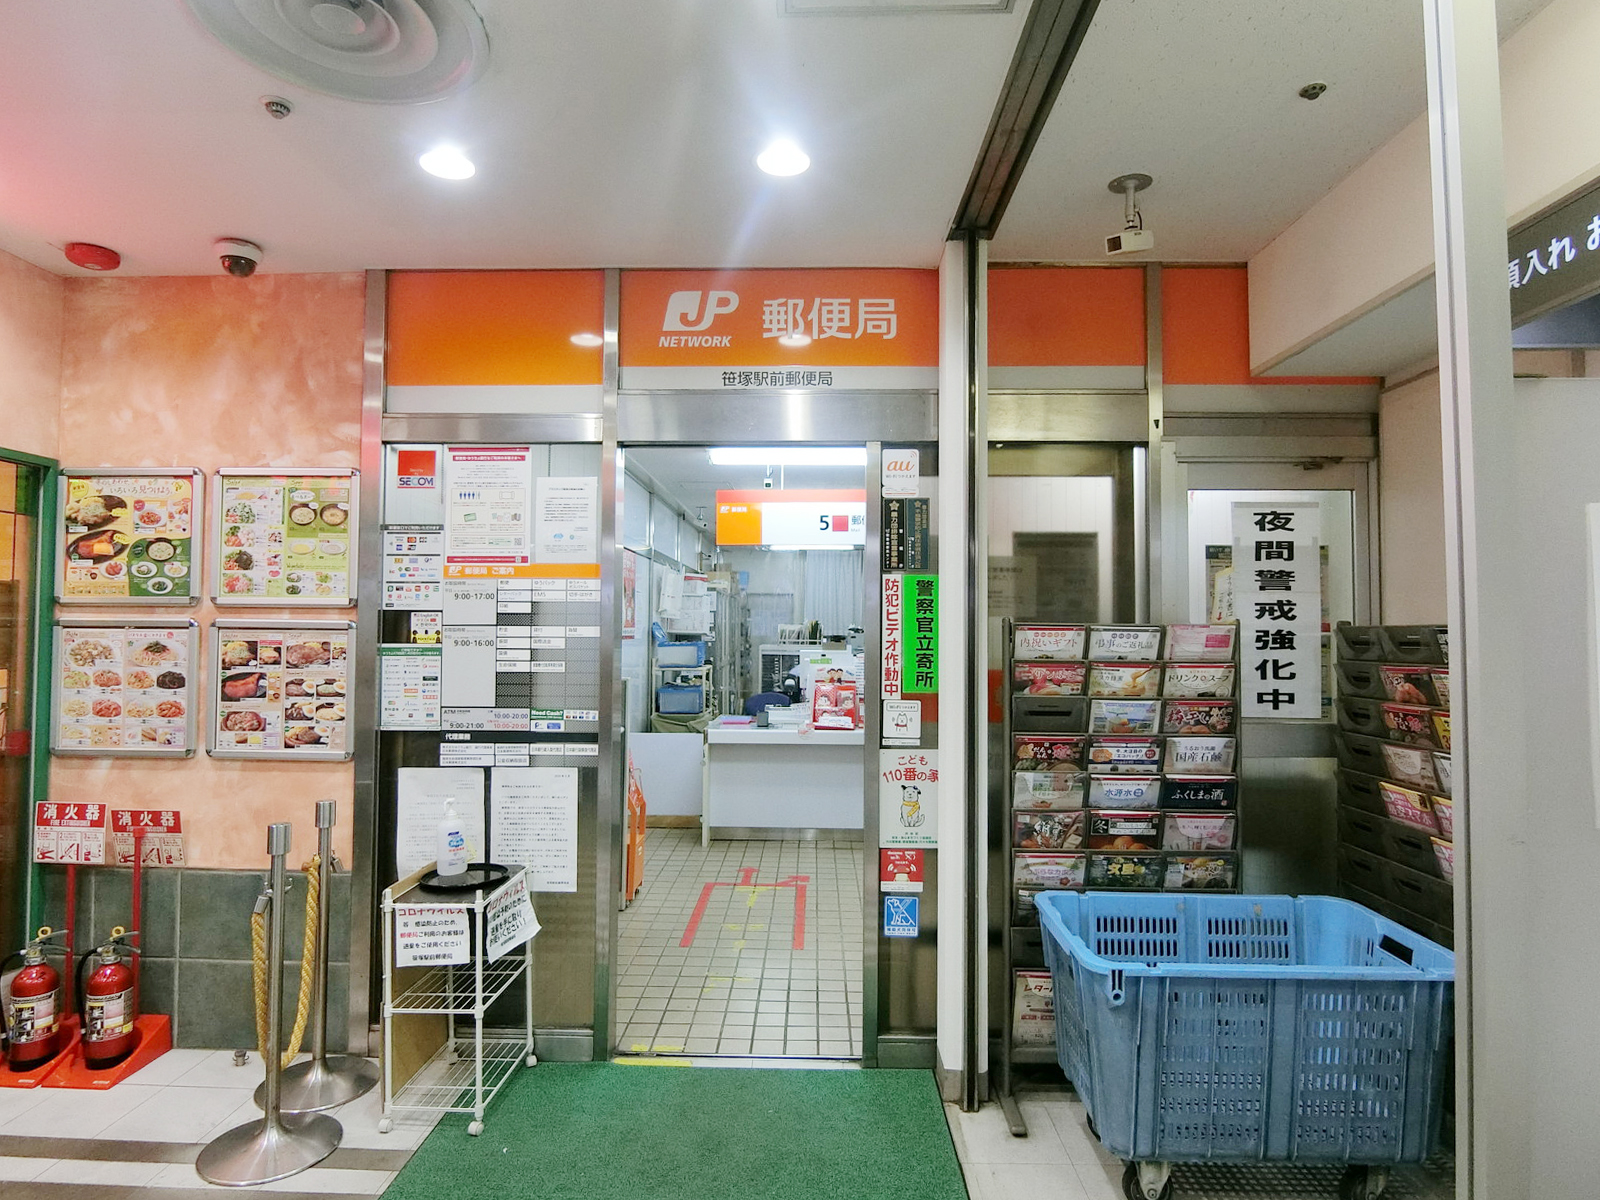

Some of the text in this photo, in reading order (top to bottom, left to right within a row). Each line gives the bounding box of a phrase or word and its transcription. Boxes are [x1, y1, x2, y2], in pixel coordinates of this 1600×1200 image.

[663, 291, 739, 331] JP
[762, 298, 897, 339] 郵便局
[659, 336, 731, 347] NETWORK
[721, 371, 833, 387] 笹塚駅前郵便局
[887, 460, 915, 471] au
[399, 477, 434, 486] SECOM
[820, 515, 829, 530] 5
[464, 567, 488, 575] 郵便局
[492, 567, 515, 575] ご案内
[1253, 511, 1297, 710] 夜間警戒強化中
[884, 578, 900, 696] 防犯ビデオ作動中
[915, 579, 934, 688] 警察官立寄所
[454, 639, 494, 647] 9:00-16:00
[1020, 638, 1078, 648] 内祝いギフト
[898, 755, 928, 766] こども
[883, 767, 939, 783] 110番の家
[1171, 788, 1225, 800] ふくしまの酒
[43, 803, 100, 820] 消火器
[118, 811, 175, 827] 消火器
